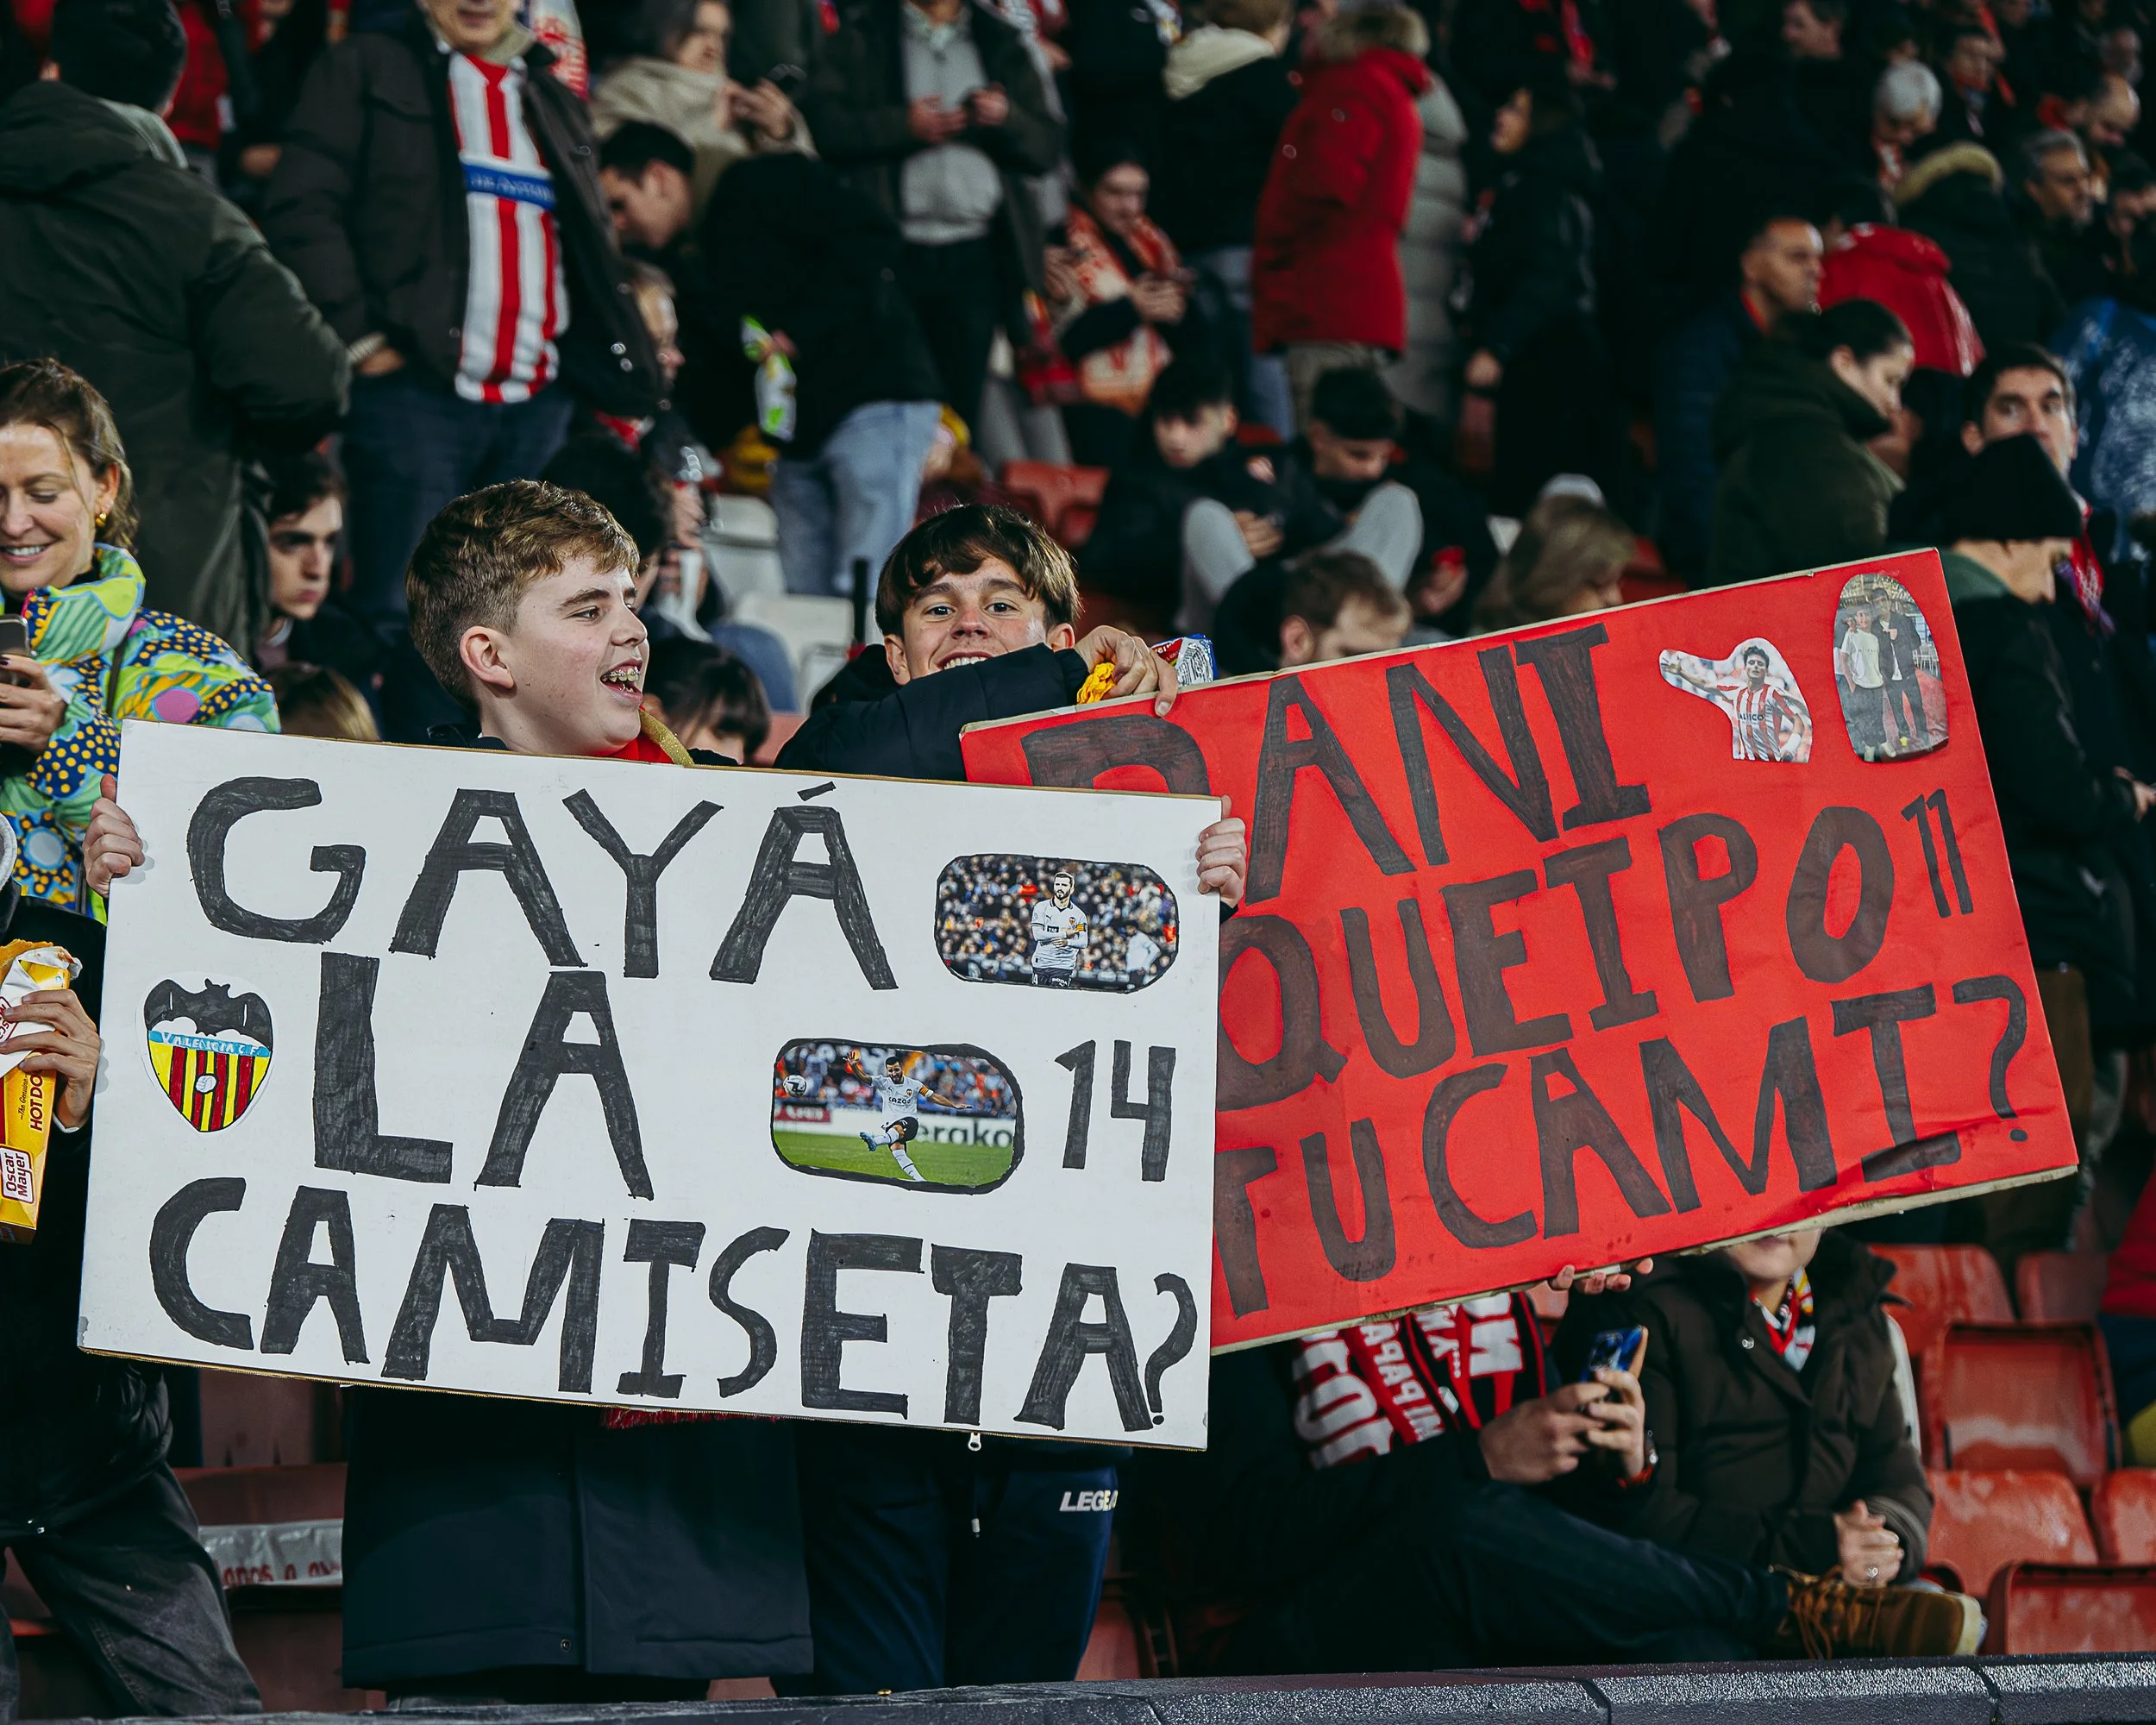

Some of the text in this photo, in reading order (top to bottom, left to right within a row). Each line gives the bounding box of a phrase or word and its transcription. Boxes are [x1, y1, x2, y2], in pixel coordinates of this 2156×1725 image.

[186, 776, 899, 990] GAYÁ
[1217, 788, 1973, 1112] QUEIPO 11
[29, 1075, 43, 1132] HOT DO
[162, 1032, 234, 1053] VALENCIA
[312, 951, 654, 1201] LA
[1055, 1040, 1175, 1182] 14
[4, 1152, 16, 1192] Oscar
[16, 1153, 31, 1197] Mayer
[1213, 1118, 1396, 1320] TU
[149, 1177, 1197, 1432] CAMISETA?
